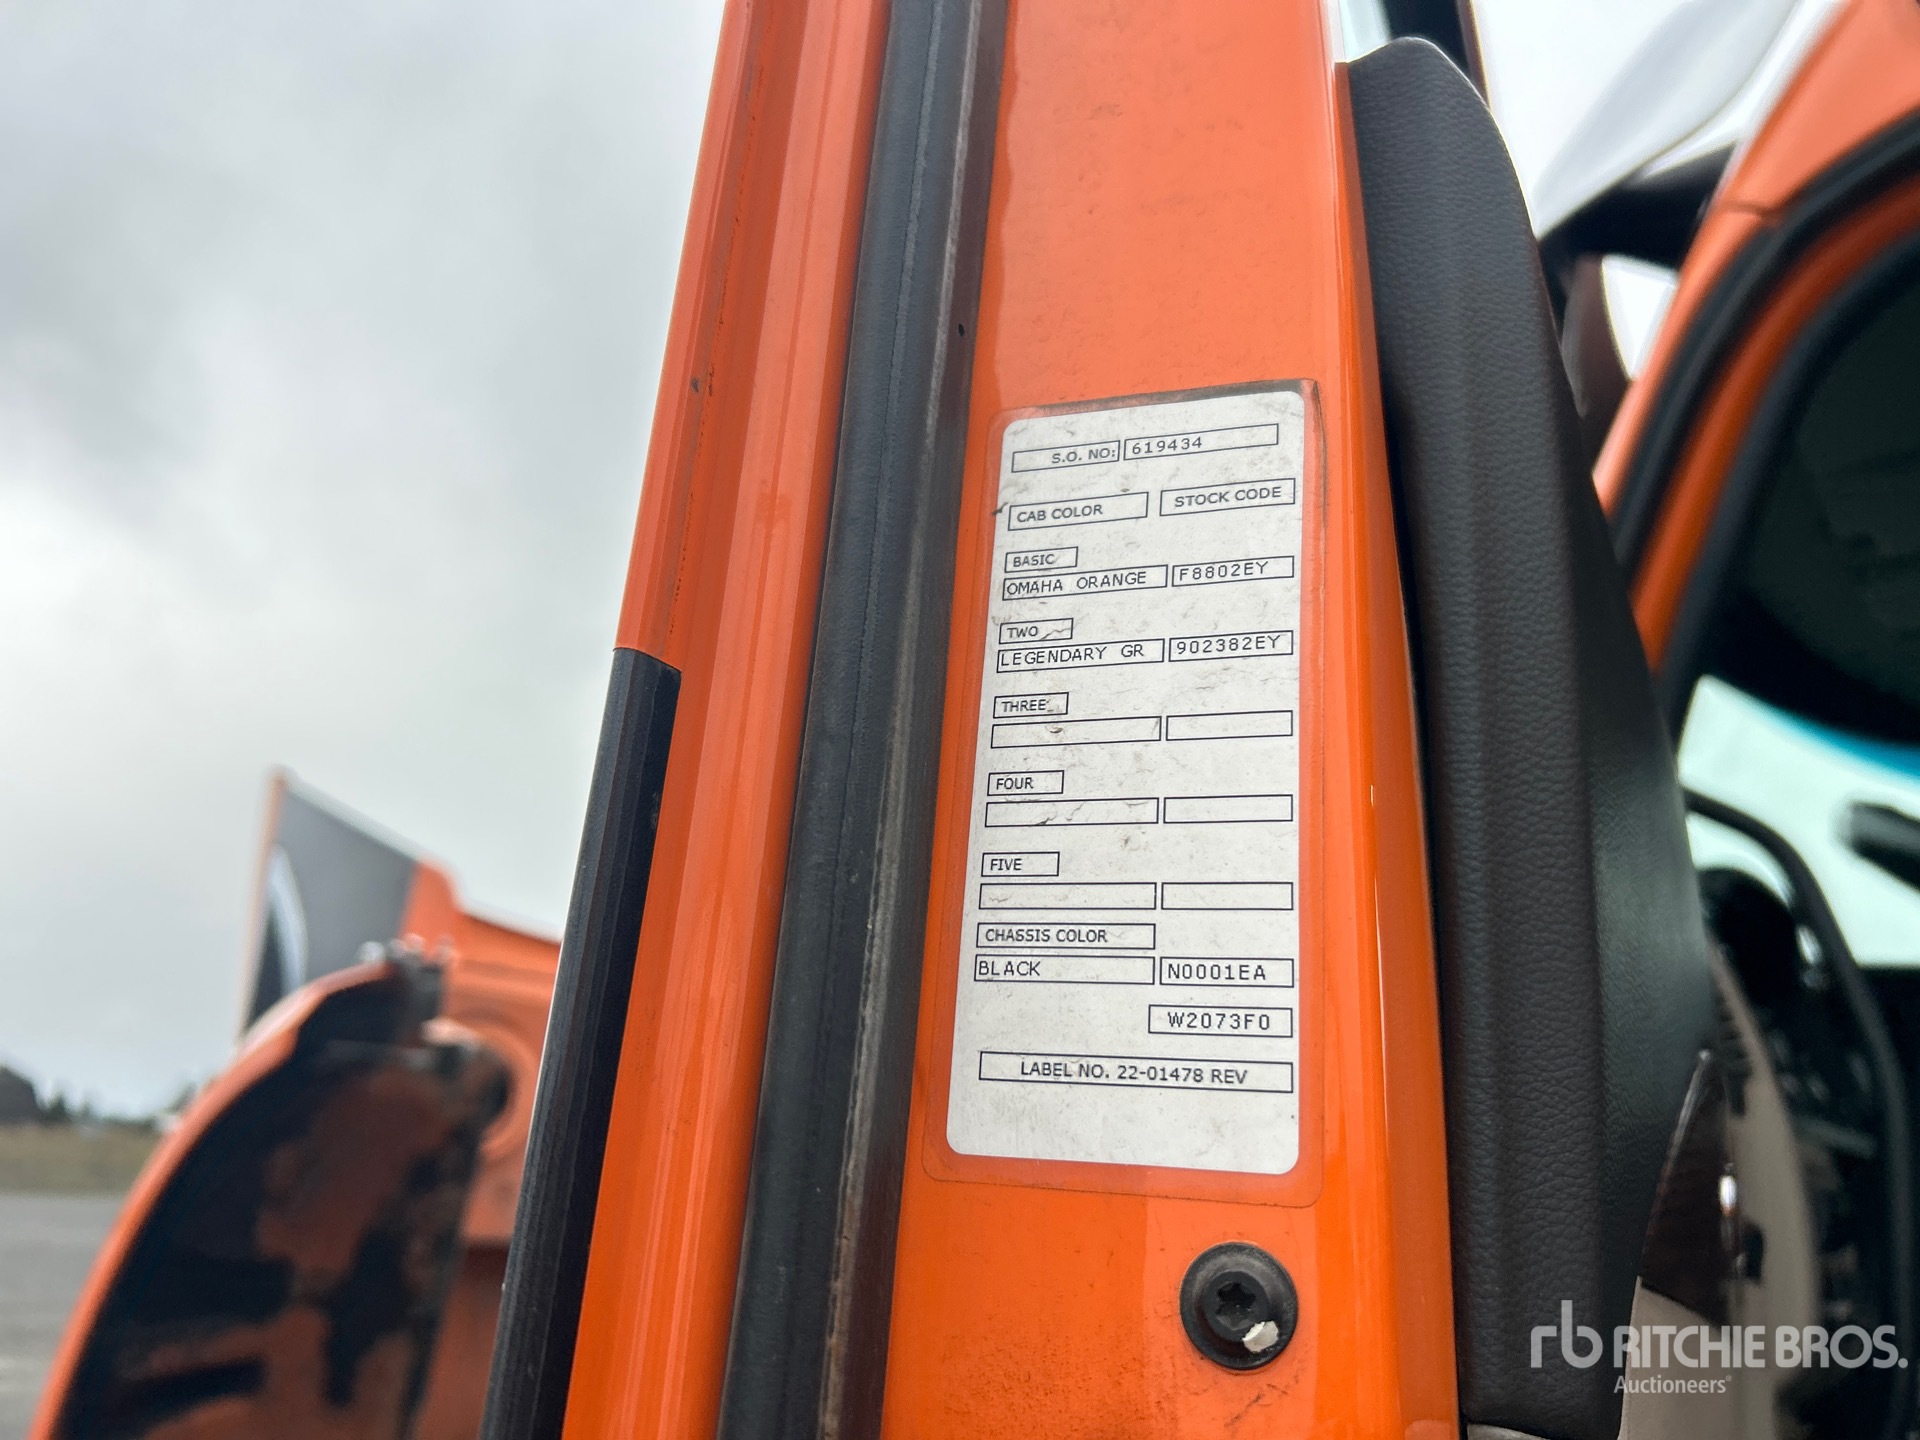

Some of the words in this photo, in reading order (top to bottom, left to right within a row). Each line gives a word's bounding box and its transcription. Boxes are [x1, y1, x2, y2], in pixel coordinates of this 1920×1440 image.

[1051, 450, 1083, 464] S.O.
[1088, 448, 1116, 461] NO:
[1132, 437, 1202, 455] 619434
[1174, 491, 1229, 507] STOCK
[1235, 486, 1282, 501] CODE
[1016, 508, 1047, 523] CAB
[1051, 504, 1103, 520] COLOR
[1013, 553, 1055, 568] BASIC
[1179, 561, 1269, 581] F8802EY
[1006, 580, 1063, 596] OMAHA
[1076, 571, 1147, 590] ORANGE
[1007, 626, 1039, 638] TWO
[1176, 635, 1281, 655] 902382EY
[1001, 646, 1107, 667] LEGENDARY
[1120, 644, 1144, 658] GR
[1001, 699, 1047, 713] THREE
[995, 777, 1034, 790] FOUR
[990, 858, 1022, 871] FIVE
[985, 928, 1051, 943] CHASSIS
[1056, 929, 1108, 943] COLOR
[978, 960, 1041, 976] BLACK
[1167, 963, 1266, 981] N0001EA
[1020, 1061, 1073, 1077] LABEL
[1078, 1064, 1109, 1079] NO.
[1117, 1065, 1204, 1083] 22-01478
[1211, 1069, 1248, 1084] REV
